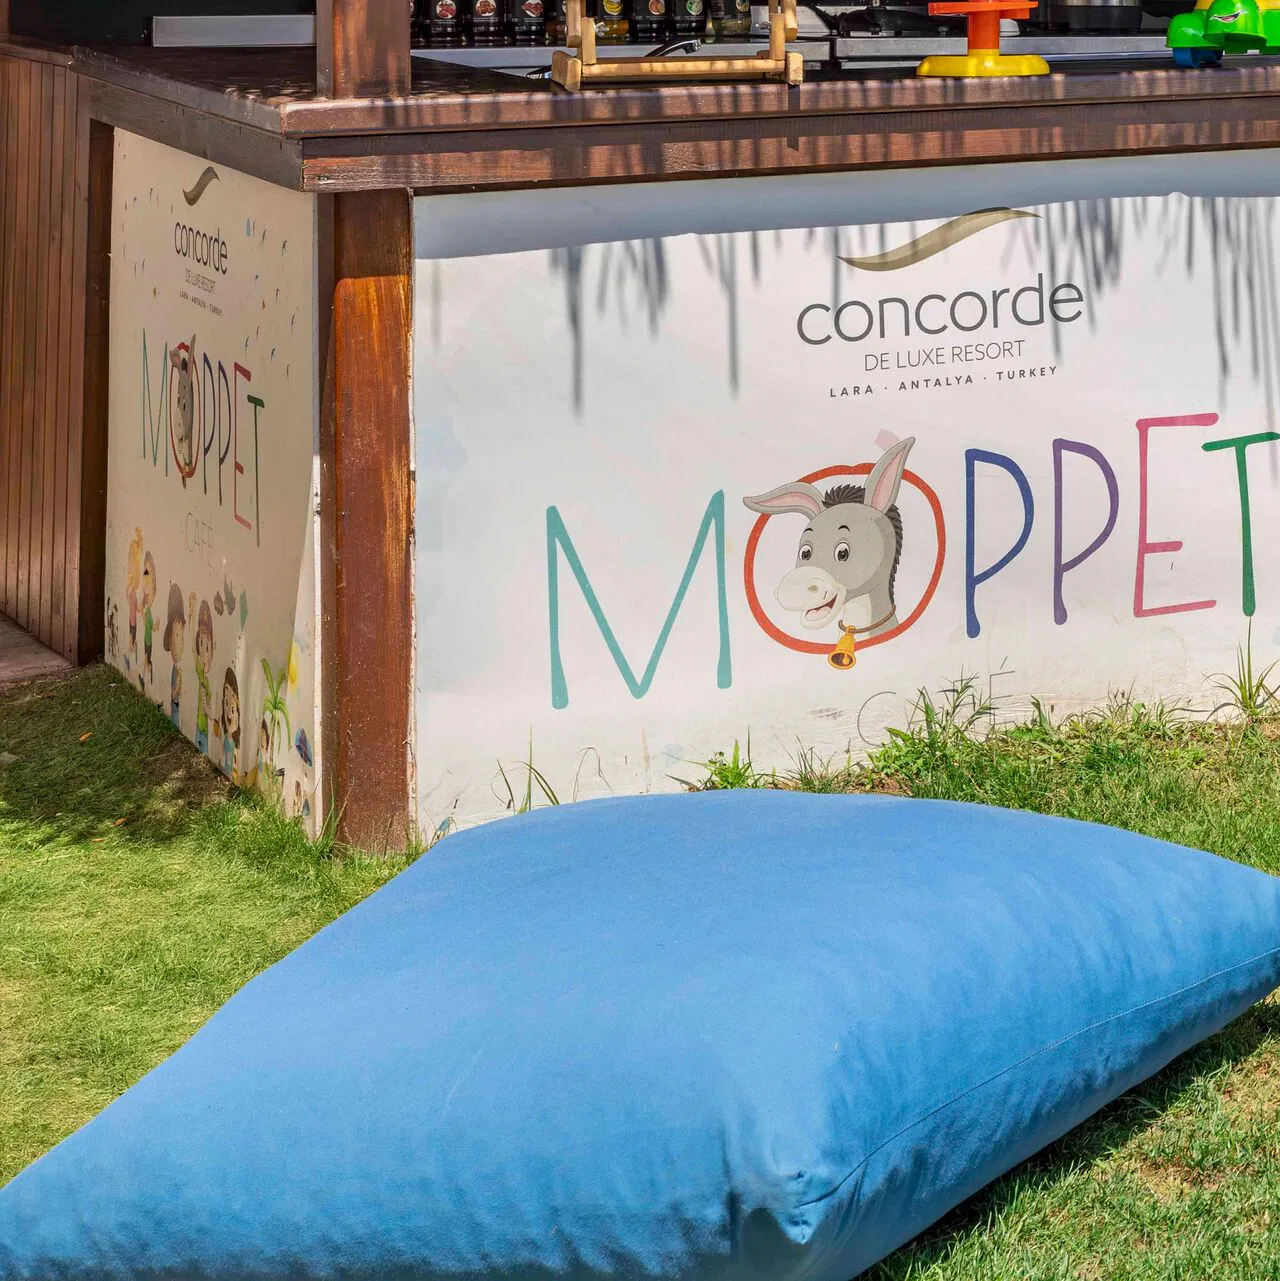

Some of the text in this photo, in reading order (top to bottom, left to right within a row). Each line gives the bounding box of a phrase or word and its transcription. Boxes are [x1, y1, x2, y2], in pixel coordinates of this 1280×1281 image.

[175, 222, 227, 275] concorde
[796, 272, 1084, 346] concorde
[830, 366, 1057, 398] LARA ANTALYA TURKEY
[864, 340, 1025, 372] DE LUXE RESORT
[142, 327, 265, 548] MOPPET
[546, 413, 1280, 710] MOPPET
